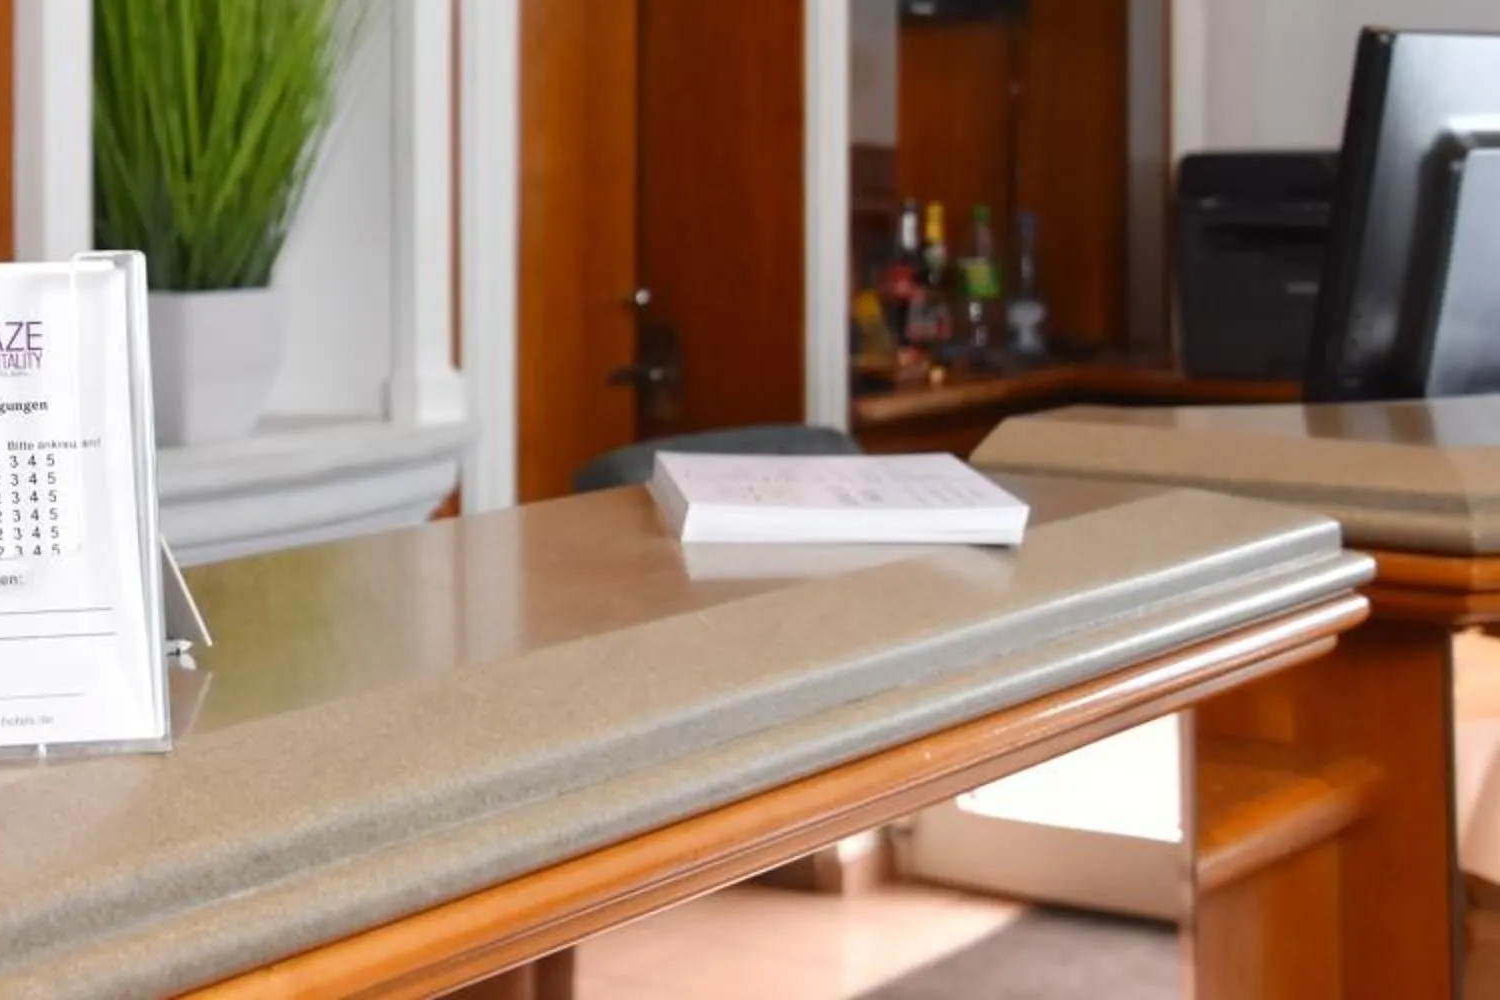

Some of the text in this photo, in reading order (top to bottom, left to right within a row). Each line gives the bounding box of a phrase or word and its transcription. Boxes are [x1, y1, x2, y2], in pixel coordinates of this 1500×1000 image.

[9, 455, 19, 469] 3
[27, 454, 37, 467] 4
[46, 453, 55, 467] 5
[10, 473, 19, 487] 3
[28, 472, 37, 485] 4
[47, 471, 57, 485] 5
[11, 491, 20, 505] 3
[29, 490, 39, 503] 4
[48, 489, 57, 503] 5
[12, 509, 21, 523] 3
[30, 508, 39, 521] 4
[49, 507, 58, 521] 5
[13, 527, 22, 541] 3
[31, 526, 41, 539] 4
[50, 525, 59, 539] 5
